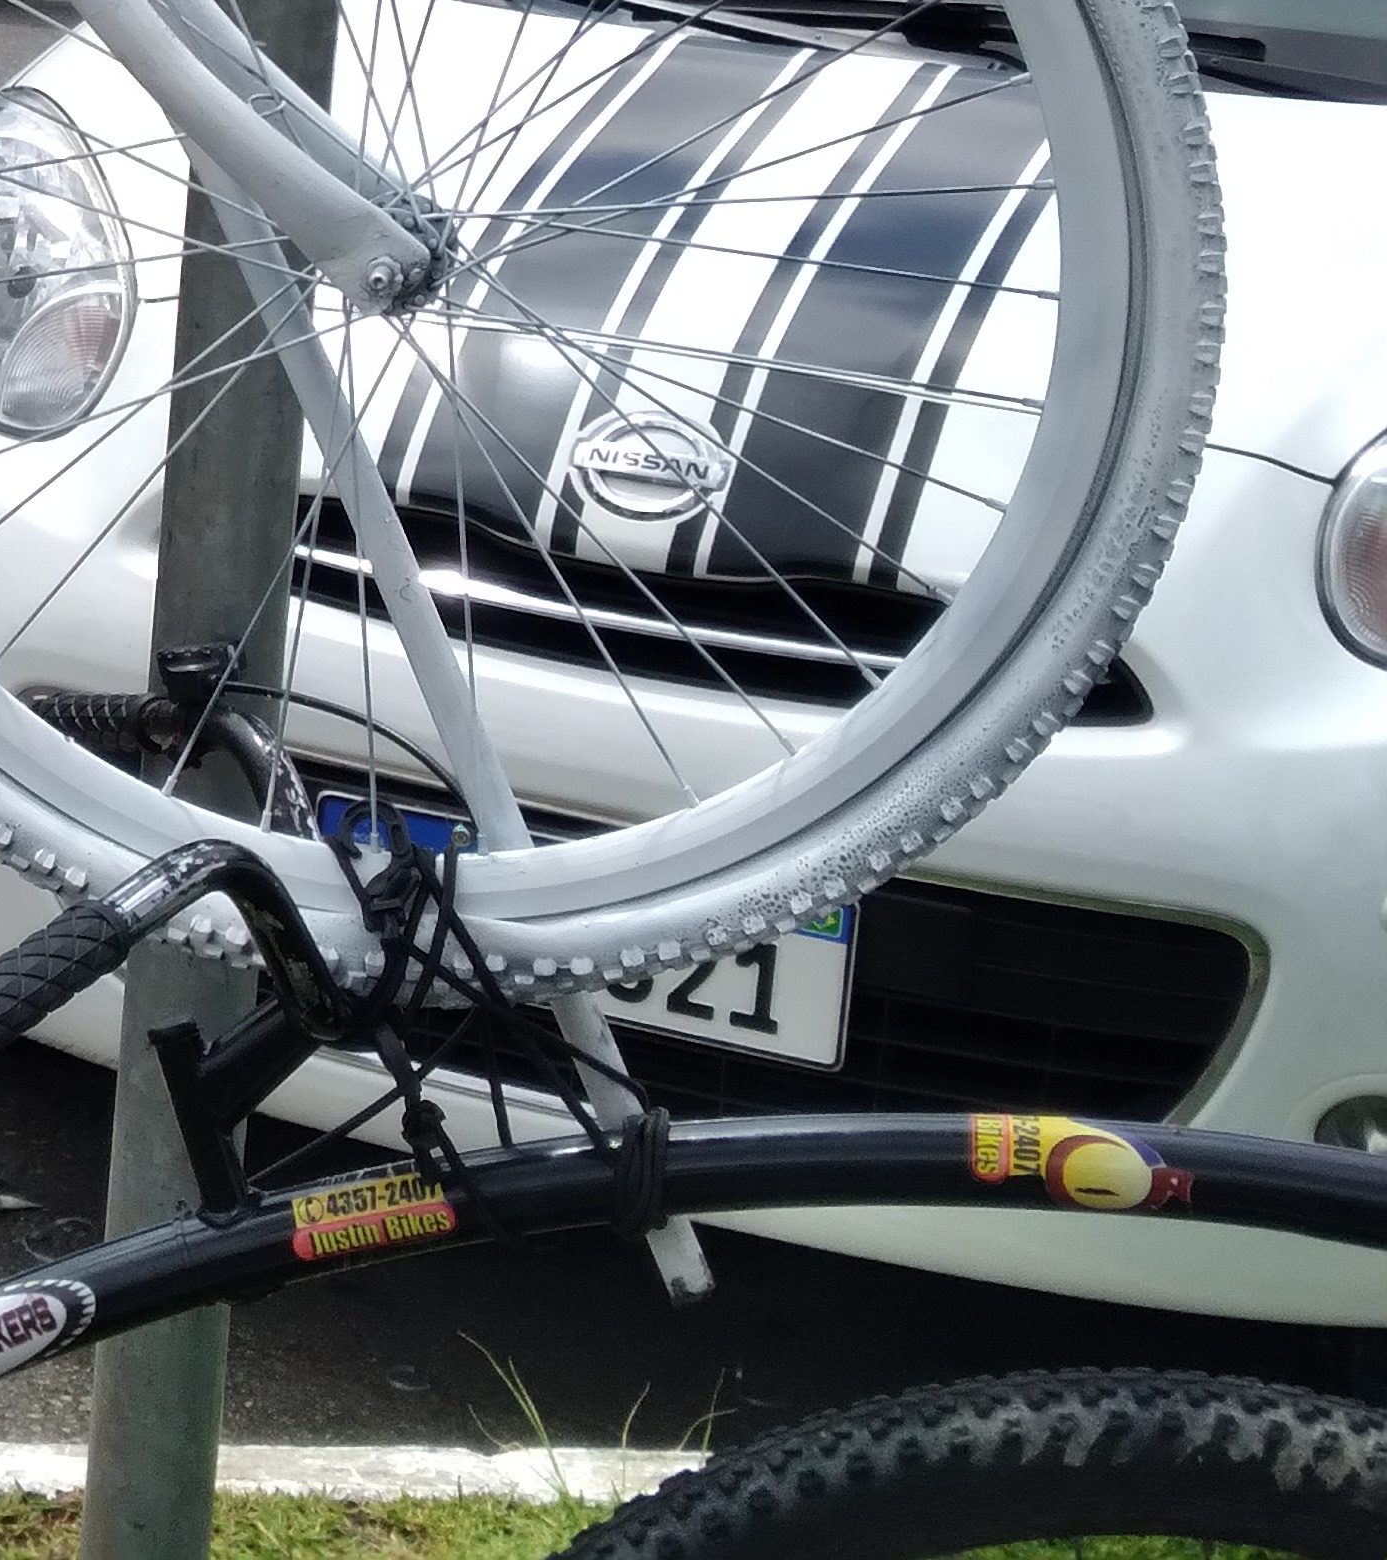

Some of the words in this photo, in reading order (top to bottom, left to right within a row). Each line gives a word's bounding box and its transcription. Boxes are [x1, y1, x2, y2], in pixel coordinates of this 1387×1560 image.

[589, 447, 709, 480] NISSAN
[607, 942, 778, 1035] 21
[312, 1222, 381, 1255] Justin
[384, 1210, 453, 1241] Bikes
